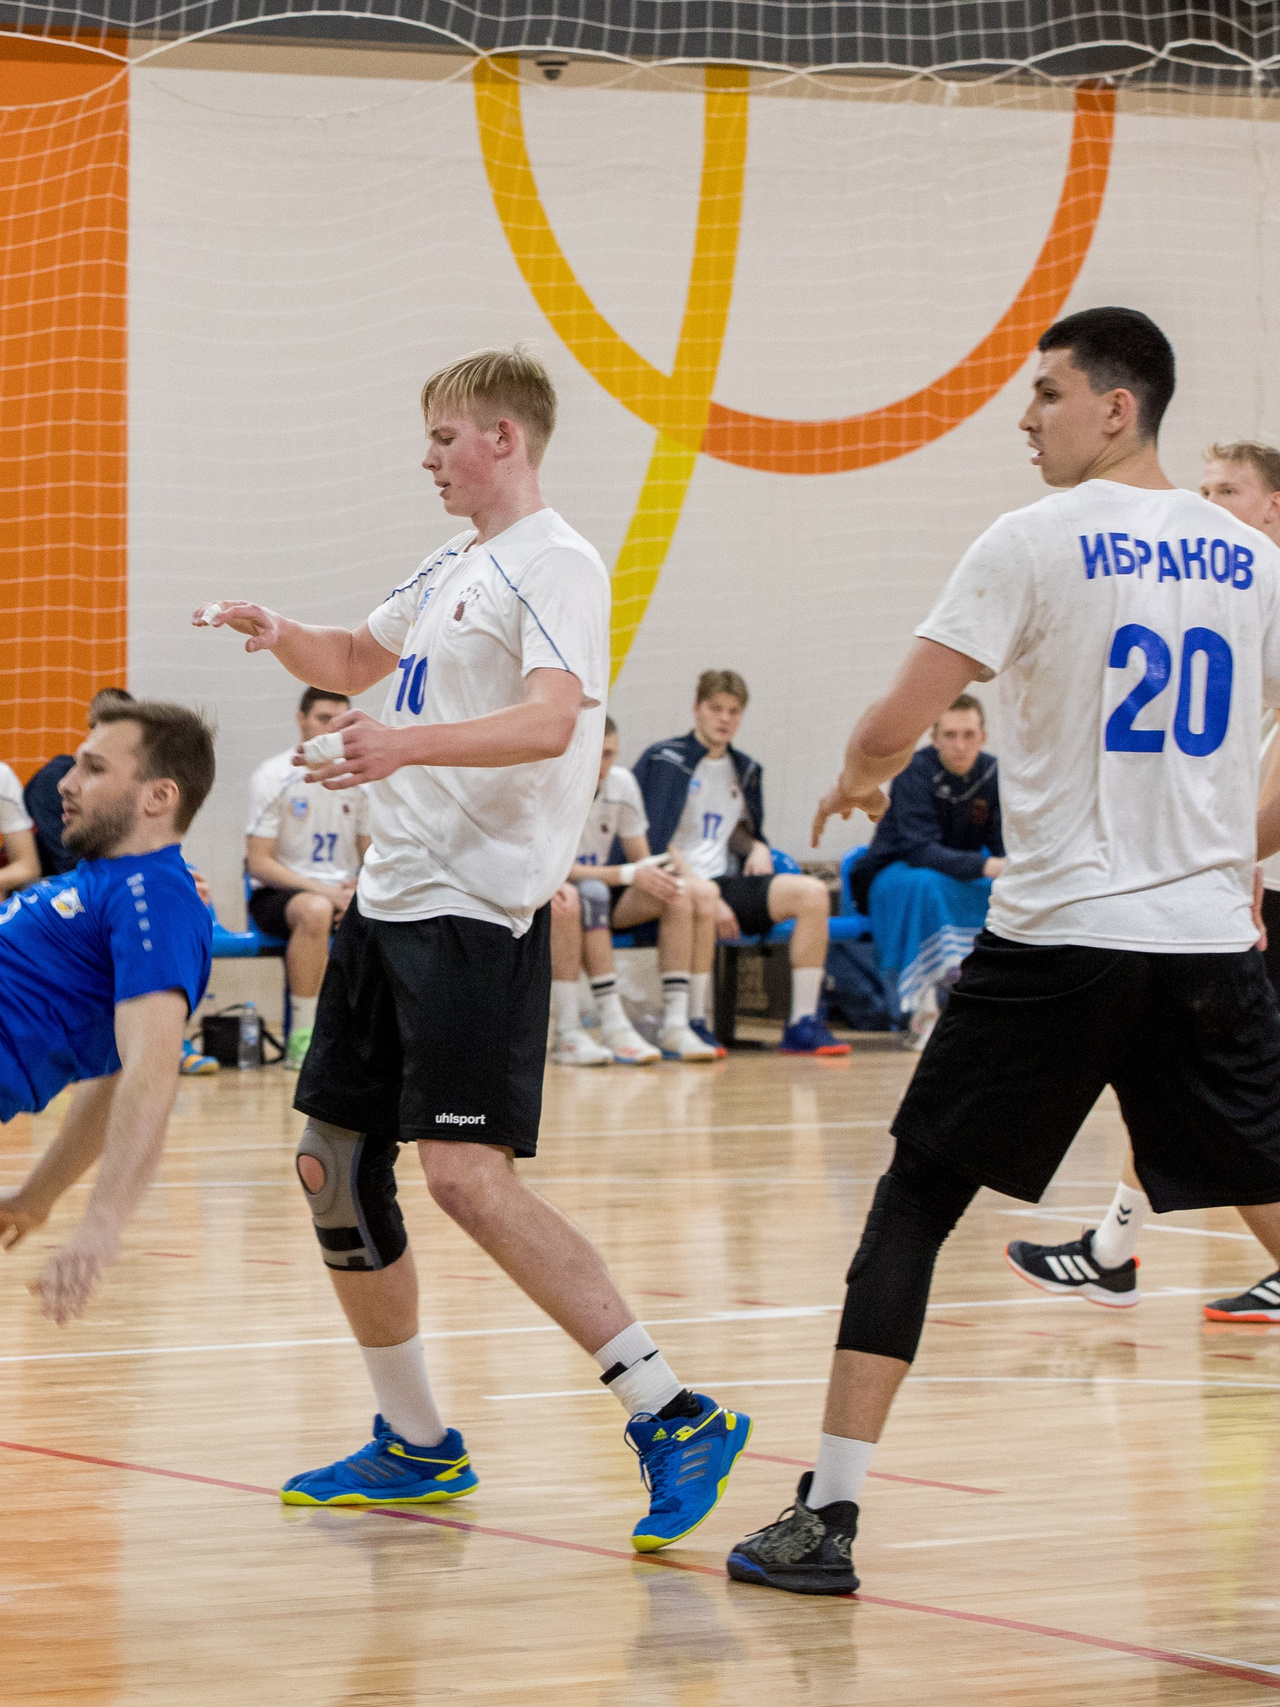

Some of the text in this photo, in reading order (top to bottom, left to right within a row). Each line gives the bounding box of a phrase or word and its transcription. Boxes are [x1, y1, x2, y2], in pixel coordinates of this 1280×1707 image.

[1080, 531, 1254, 590] ИБРАКОВ
[395, 653, 428, 716] 10
[1105, 623, 1233, 757] 20
[312, 832, 339, 862] 27
[435, 1112, 486, 1127] uhlsport
